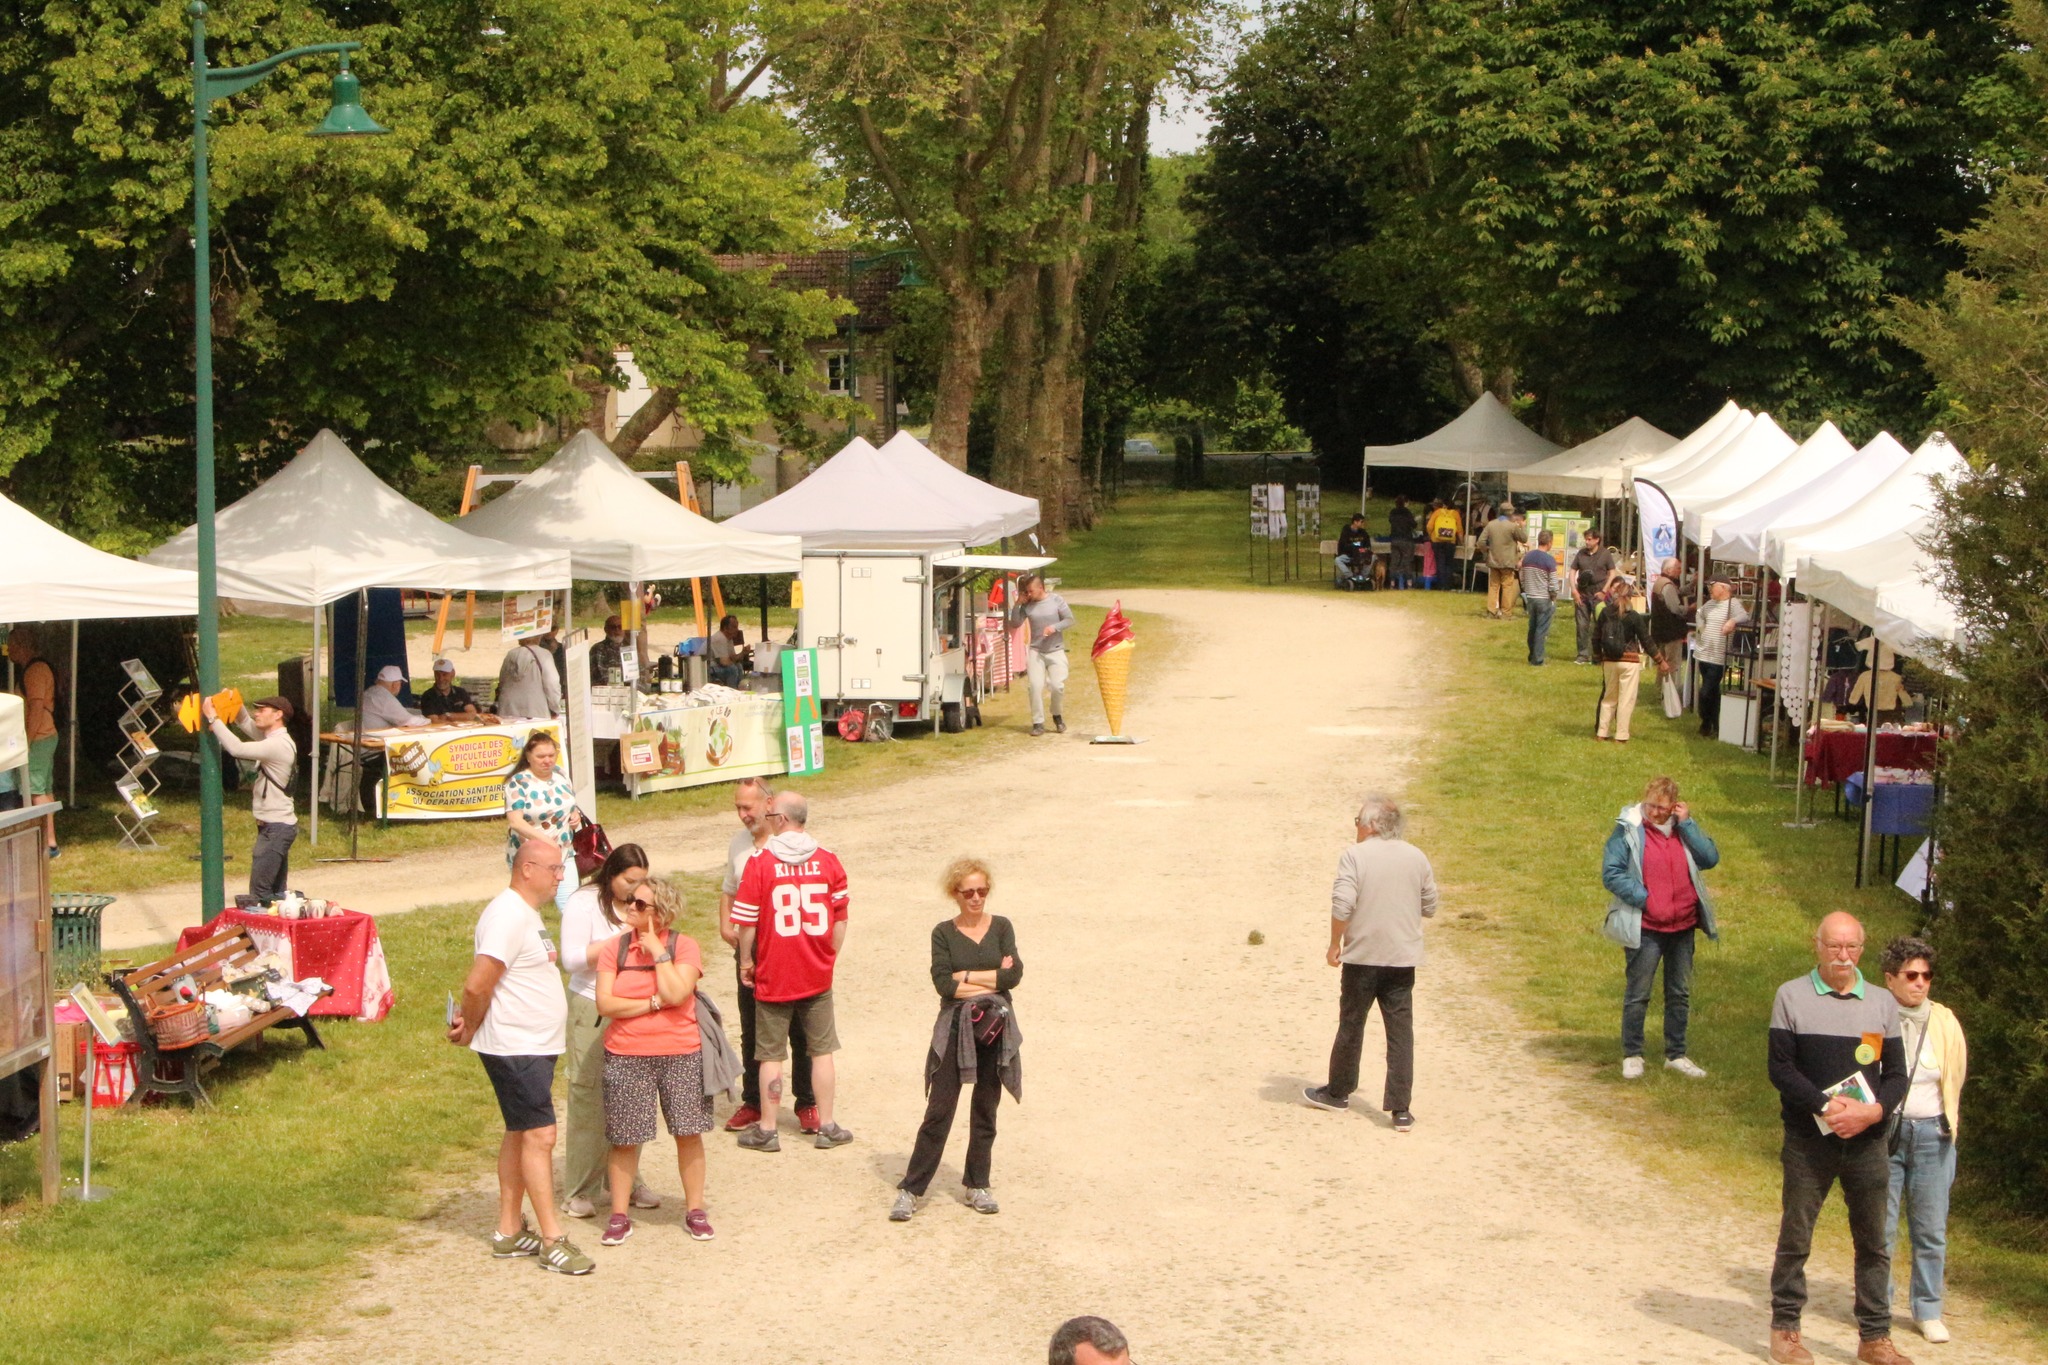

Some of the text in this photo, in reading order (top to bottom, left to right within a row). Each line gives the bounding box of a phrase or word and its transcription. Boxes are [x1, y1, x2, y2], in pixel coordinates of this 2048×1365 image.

[449, 739, 503, 753] SYNDICAT DES
[450, 749, 502, 762] APICULTEURS
[454, 759, 498, 771] DE L'YONNE
[406, 783, 506, 798] ASSOCIATION SANITAIRE
[413, 796, 423, 805] DU
[489, 793, 499, 802] DE
[774, 861, 821, 878] KITTLE
[772, 883, 829, 937] 85
